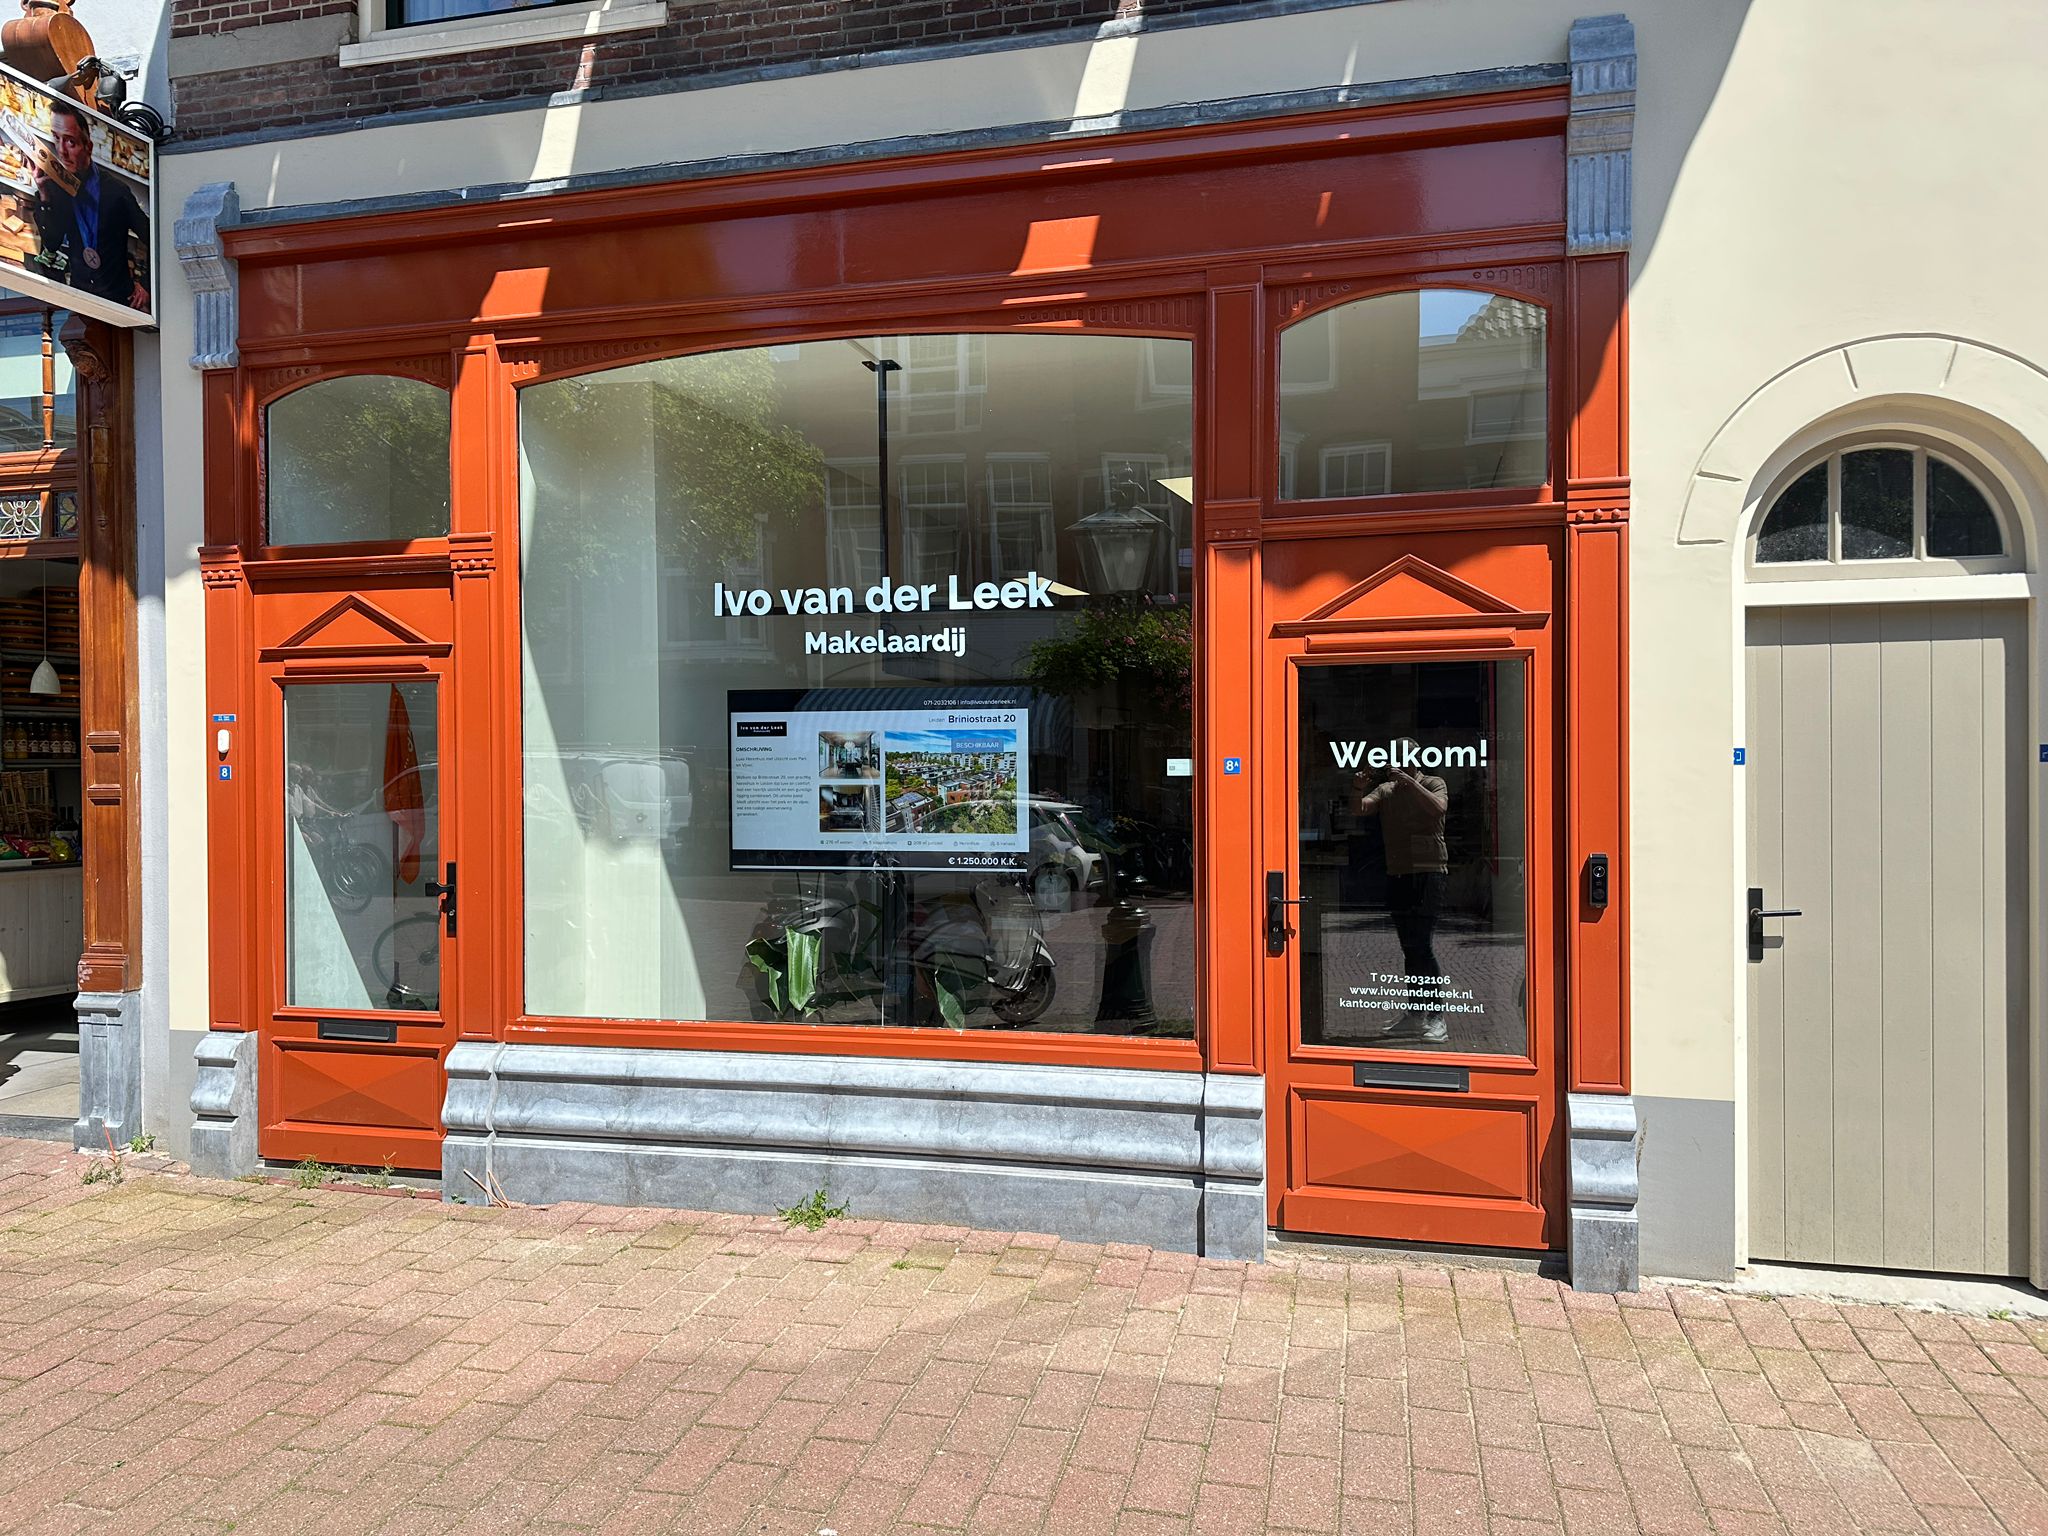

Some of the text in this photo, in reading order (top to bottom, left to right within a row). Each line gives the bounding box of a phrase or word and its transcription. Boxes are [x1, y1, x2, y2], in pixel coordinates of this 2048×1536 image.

[714, 571, 1055, 617] Ivo van der Leek
[805, 627, 966, 658] Makelaardij
[948, 714, 1001, 723] Briniostraat
[1003, 714, 1016, 723] 20
[1329, 739, 1488, 768] Welkom!
[221, 767, 228, 778] 8
[957, 856, 999, 865] 1.250.000
[1000, 857, 1018, 866] K.K.
[1370, 972, 1451, 985] T 071-2032106
[1349, 985, 1474, 1000] www.ivovanderleek.nl
[1339, 997, 1485, 1014] kantoor@ivovanderleek.nl
